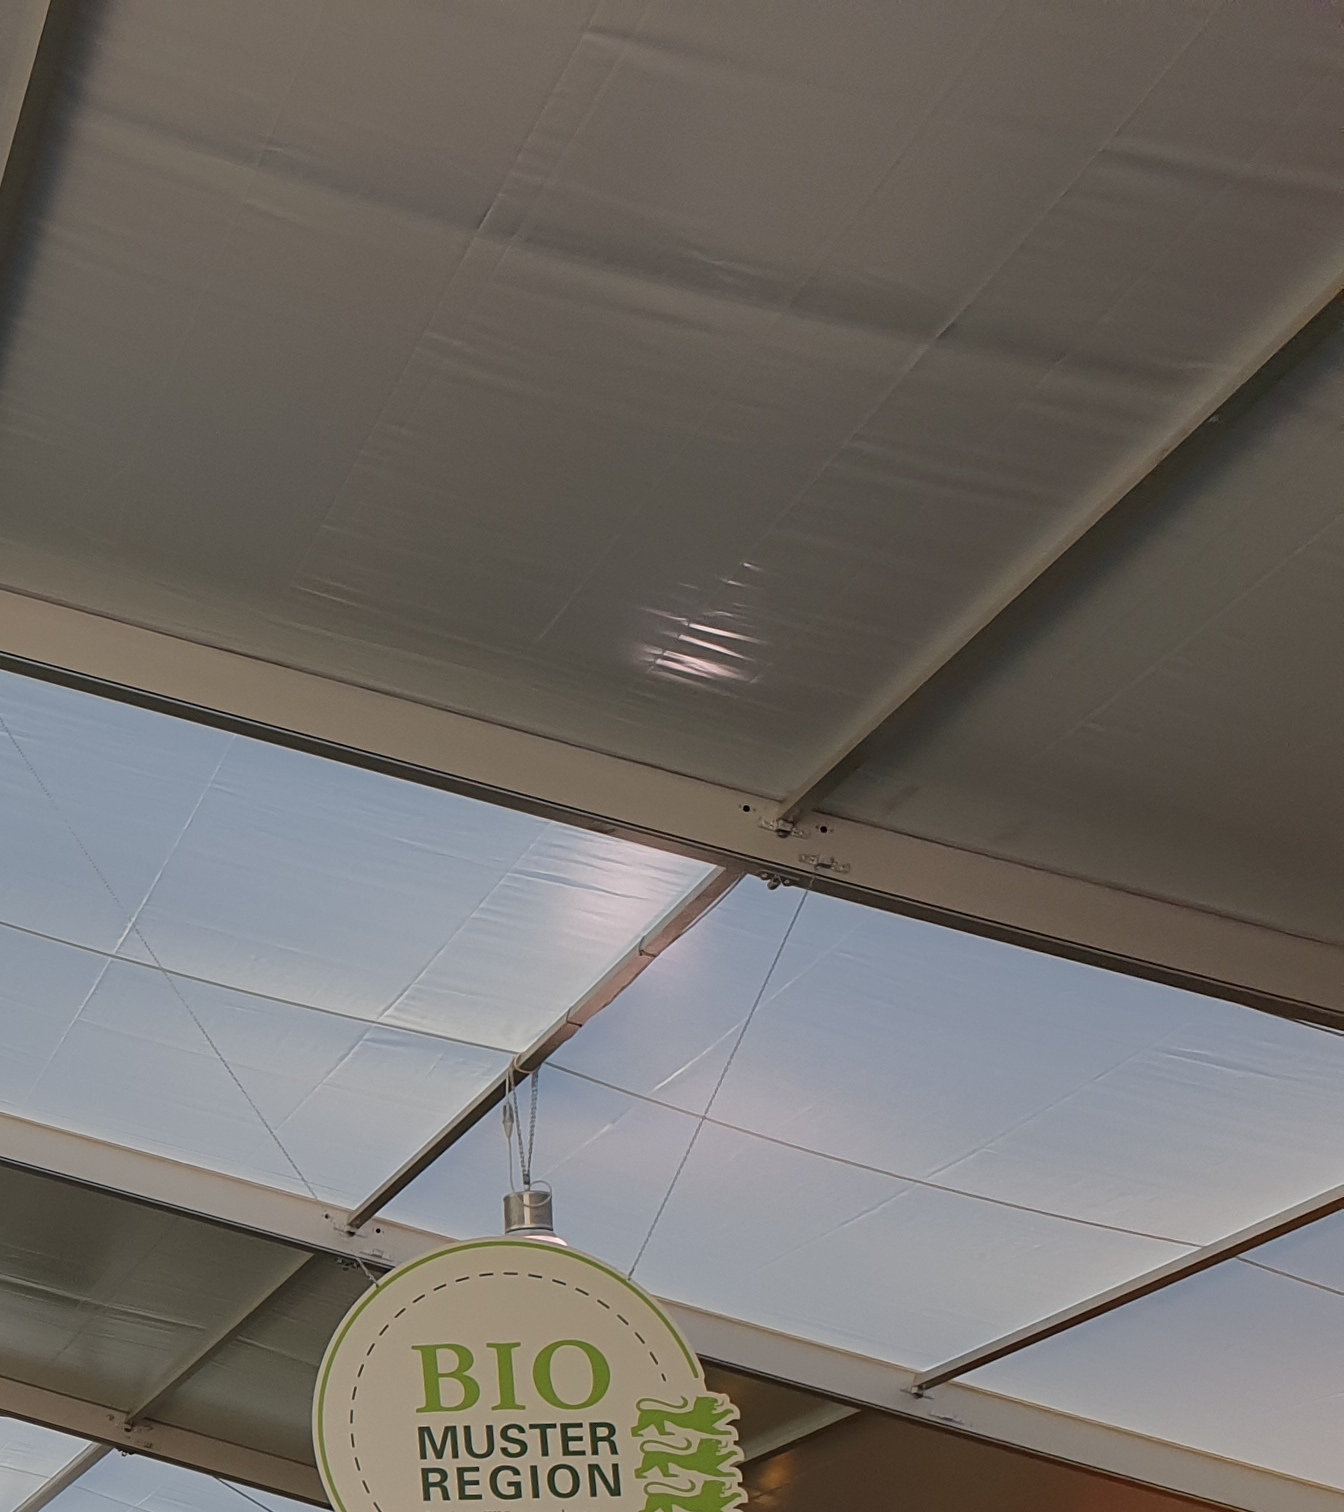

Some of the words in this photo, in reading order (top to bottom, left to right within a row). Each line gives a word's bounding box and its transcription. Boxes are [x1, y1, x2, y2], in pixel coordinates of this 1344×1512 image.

[411, 1339, 611, 1415] BIO
[417, 1421, 620, 1460] MUSTER
[421, 1463, 622, 1501] REGION
